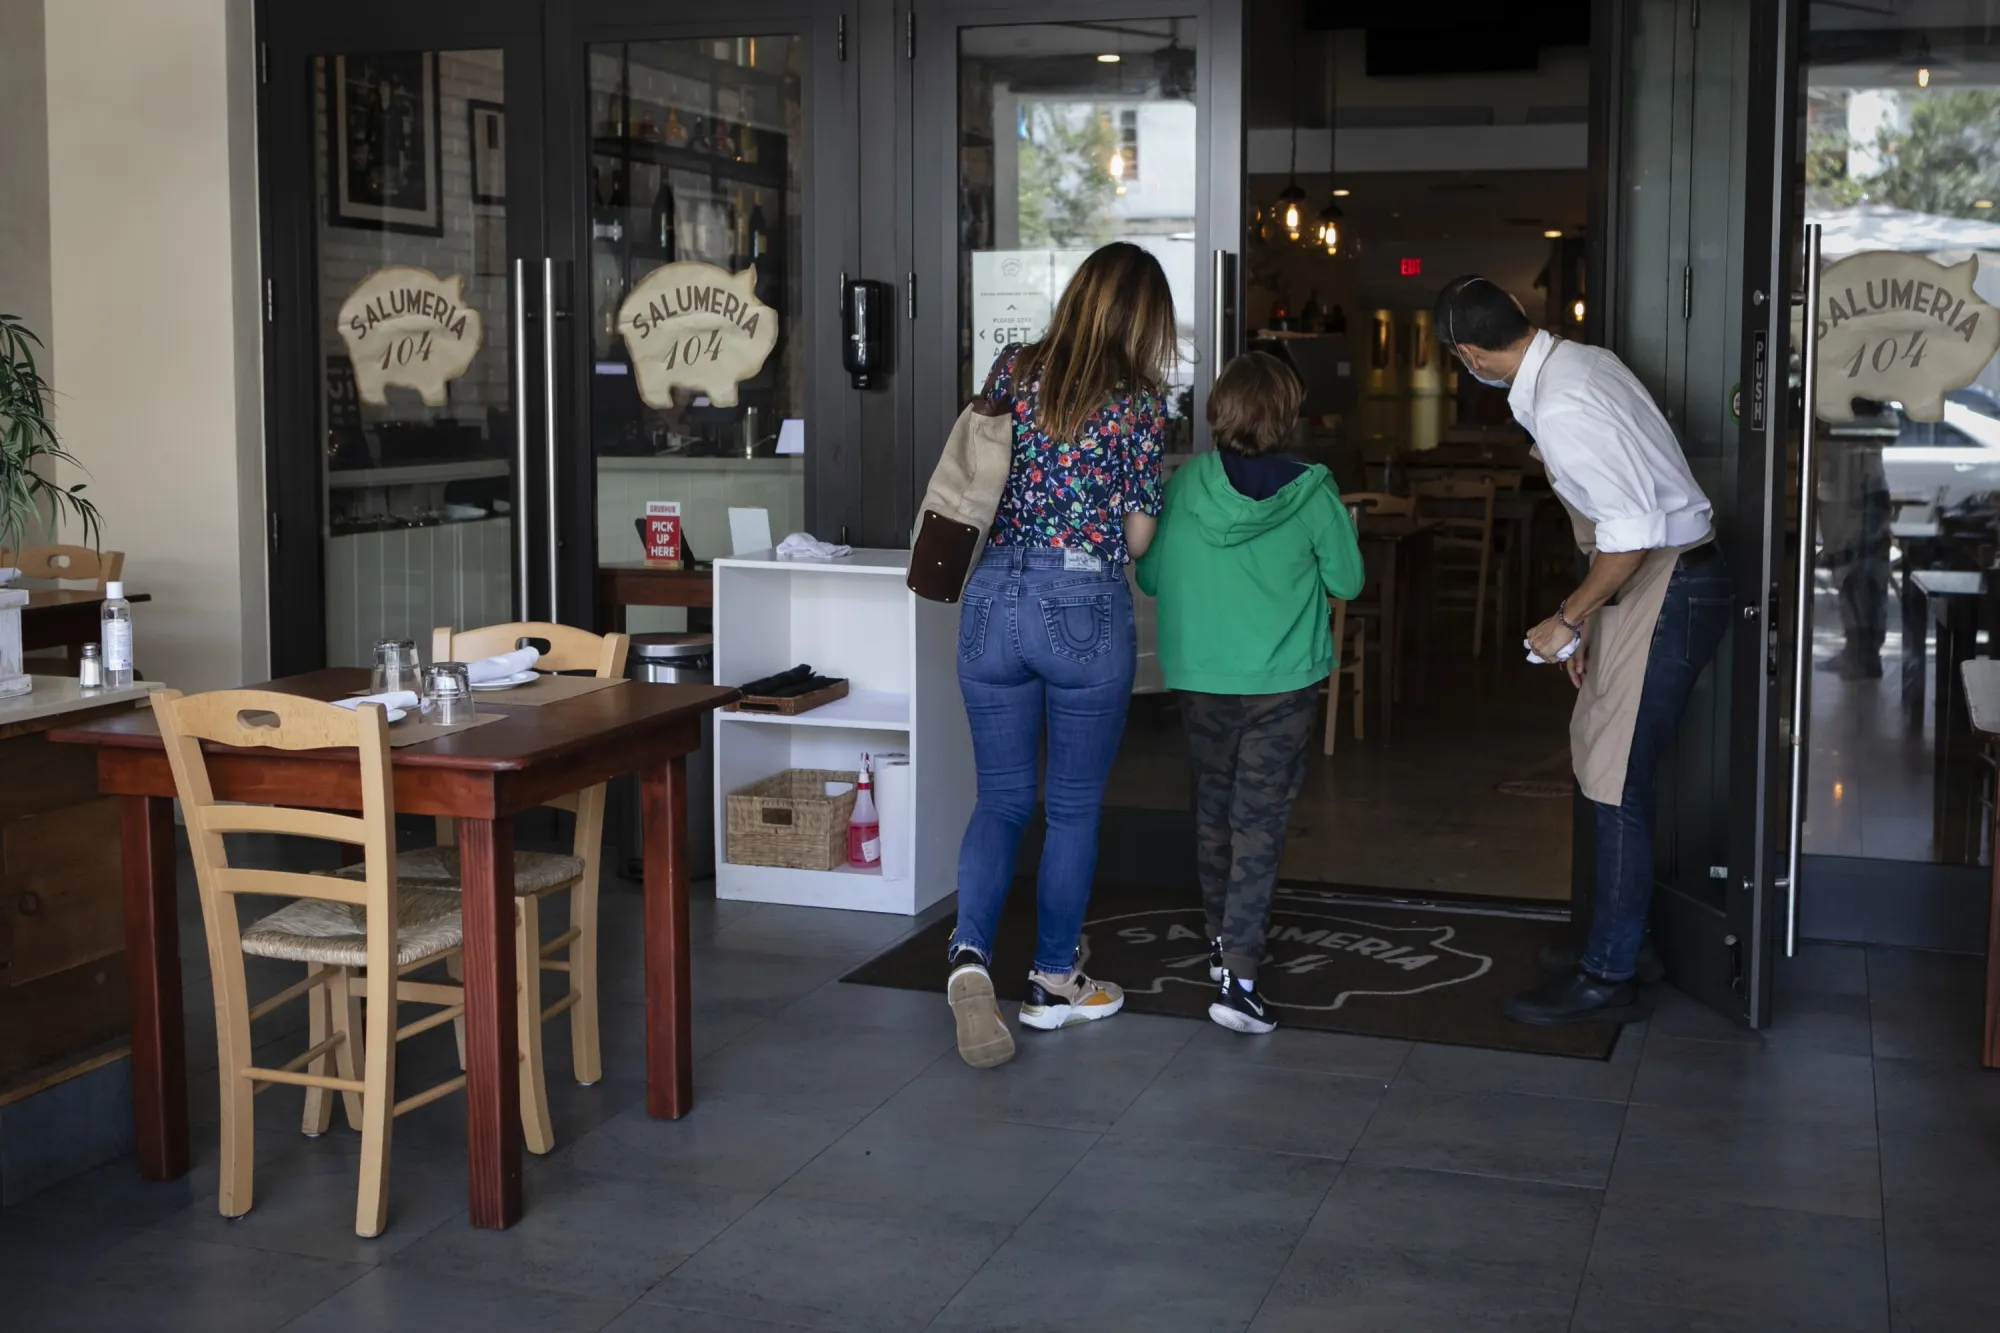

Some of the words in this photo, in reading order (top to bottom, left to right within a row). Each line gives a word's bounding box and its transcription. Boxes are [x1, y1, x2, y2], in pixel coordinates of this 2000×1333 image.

[351, 288, 467, 340] SALUMERIA
[633, 285, 760, 339] SALUMERIA
[379, 330, 434, 370] 104
[662, 328, 723, 371] 104
[993, 327, 1031, 344] 6FT
[1843, 330, 1928, 379] 104
[1754, 341, 1764, 420] PUSH
[650, 505, 676, 513] GRUBHUB
[652, 521, 674, 532] PICK
[650, 545, 675, 557] HERE
[656, 533, 670, 545] UP
[1117, 924, 1438, 971] SAMERIA
[1161, 953, 1334, 974] 14
